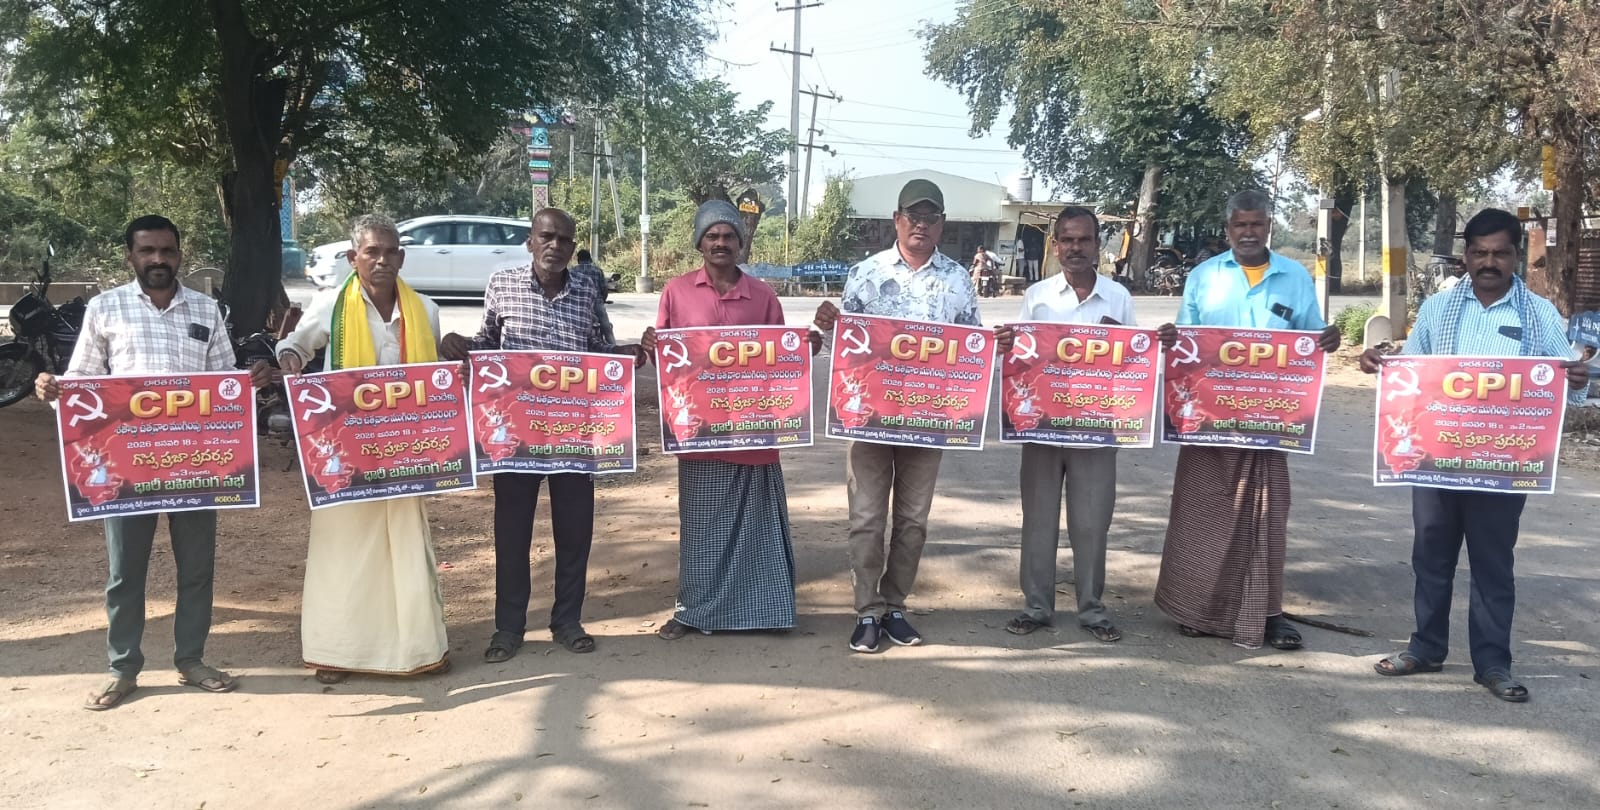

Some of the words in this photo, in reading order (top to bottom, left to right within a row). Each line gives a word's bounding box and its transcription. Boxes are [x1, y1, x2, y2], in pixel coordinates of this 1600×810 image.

[709, 341, 775, 366] CPI
[890, 333, 957, 364] CPI
[1056, 337, 1122, 365] CPI
[1219, 341, 1287, 367] CPI
[529, 364, 598, 394] CPI
[1442, 371, 1521, 400] CPI
[129, 389, 211, 418] CPI
[352, 380, 426, 411] CPI
[132, 452, 159, 470] గొప్ప
[160, 450, 188, 467] ప్రజా
[190, 448, 233, 466] ప్రదర్శన
[133, 477, 161, 494] భారీ
[164, 474, 219, 491] బహిరంగ
[223, 474, 245, 488] సభ
